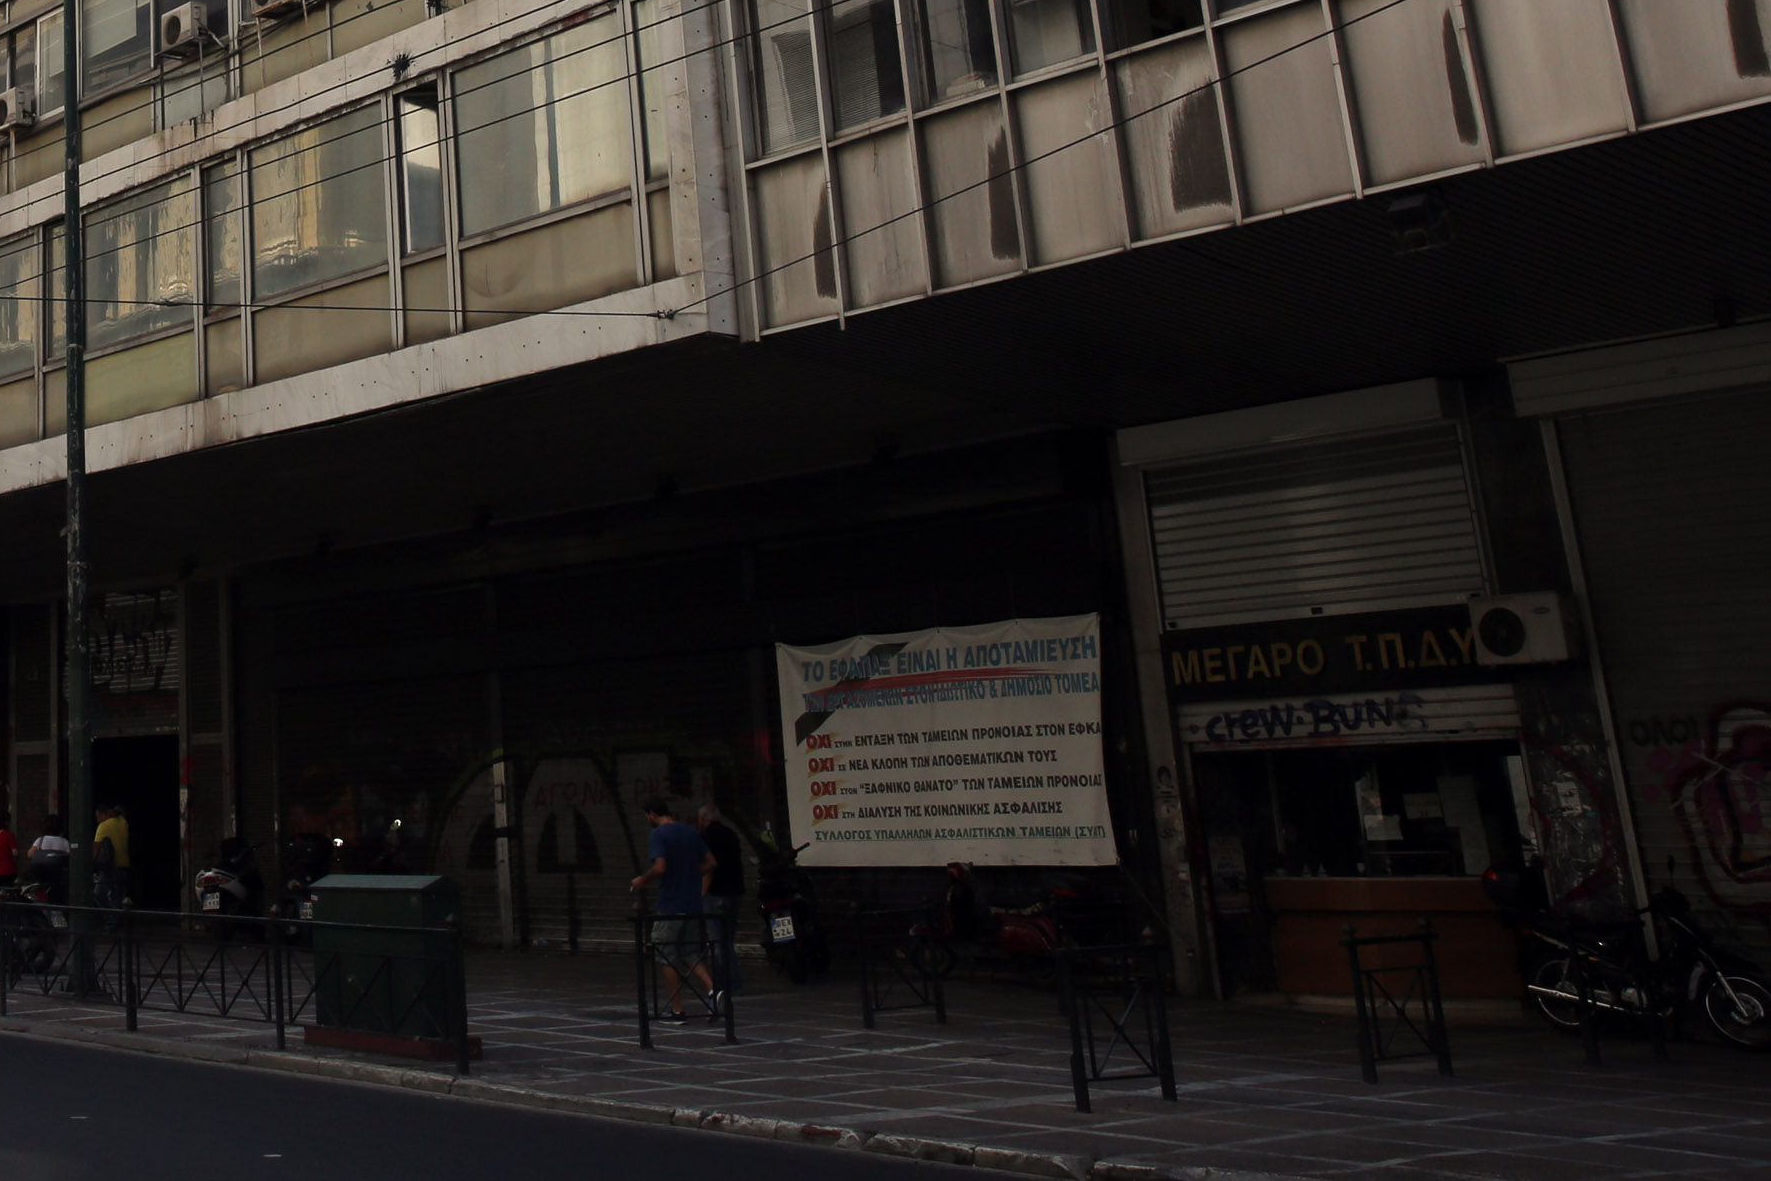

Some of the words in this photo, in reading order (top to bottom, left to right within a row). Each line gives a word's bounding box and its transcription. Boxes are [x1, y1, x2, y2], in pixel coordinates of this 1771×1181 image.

[802, 661, 824, 682] ΤΟ
[829, 653, 891, 681] ΕΦΑΠΑΞ
[897, 648, 941, 674] ΕΙΝΑΙ
[946, 647, 958, 669] Η
[963, 635, 1098, 668] ΑΠΟΤΑΜΙΕΥΣΗ
[1171, 639, 1325, 687] ΜΕΓΑΡΟ
[989, 678, 998, 698] &
[1001, 674, 1053, 697] ΔΗΜΟΣΙΟ
[1055, 672, 1100, 694] ΤΟΜΕΑ
[806, 734, 832, 749] ΟΧΙ
[834, 740, 853, 748] ΣΤΗΝ
[855, 733, 895, 747] ΕΝΤΑΞΗ
[897, 732, 919, 744] ΤΩΝ
[922, 729, 968, 743] ΤΑΜΕΙΩΝ
[972, 725, 1033, 740] ΠΡΟΝΟΙΑΣ
[1035, 723, 1065, 737] ΣΤΟΝ
[1069, 722, 1101, 736] ΕΦΚΑ
[808, 757, 835, 773] ΟΧΙ
[849, 758, 869, 771] ΝΕΑ
[871, 757, 908, 770] ΚΛΟΠΗ
[911, 755, 929, 768] ΤΩΝ
[932, 751, 1024, 767] ΑΠΟΘΕΜΑΤΙΚΩΝ
[1027, 750, 1058, 763] ΤΟΥΣ
[810, 781, 837, 796] ΟΧΙ
[840, 787, 858, 795] ΣΤΟΝ
[962, 778, 985, 790] ΤΩΝ
[987, 776, 1044, 789] ΤΑΜΕΙΩΝ
[813, 804, 839, 820] ΟΧΙ
[842, 811, 856, 819] ΣΤΗ
[858, 806, 902, 818] ΔΙΑΛΥΣΗ
[904, 805, 922, 817] ΤΗΣ
[924, 803, 990, 817] ΚΟΙΝΩΝΙΚΗΣ
[993, 801, 1064, 815] ΑΣΦΑΛΙΣΗΣ
[815, 830, 872, 841] ΣΥΛΛΟΓΟΣ
[874, 828, 932, 840] ΥΠΑΛΛΗΛΩΝ
[934, 827, 1016, 839] ΑΣΦΑΛΙΣΤΙΚΩΝ
[1019, 826, 1071, 838] ΤΑΜΕΙΩΝ
